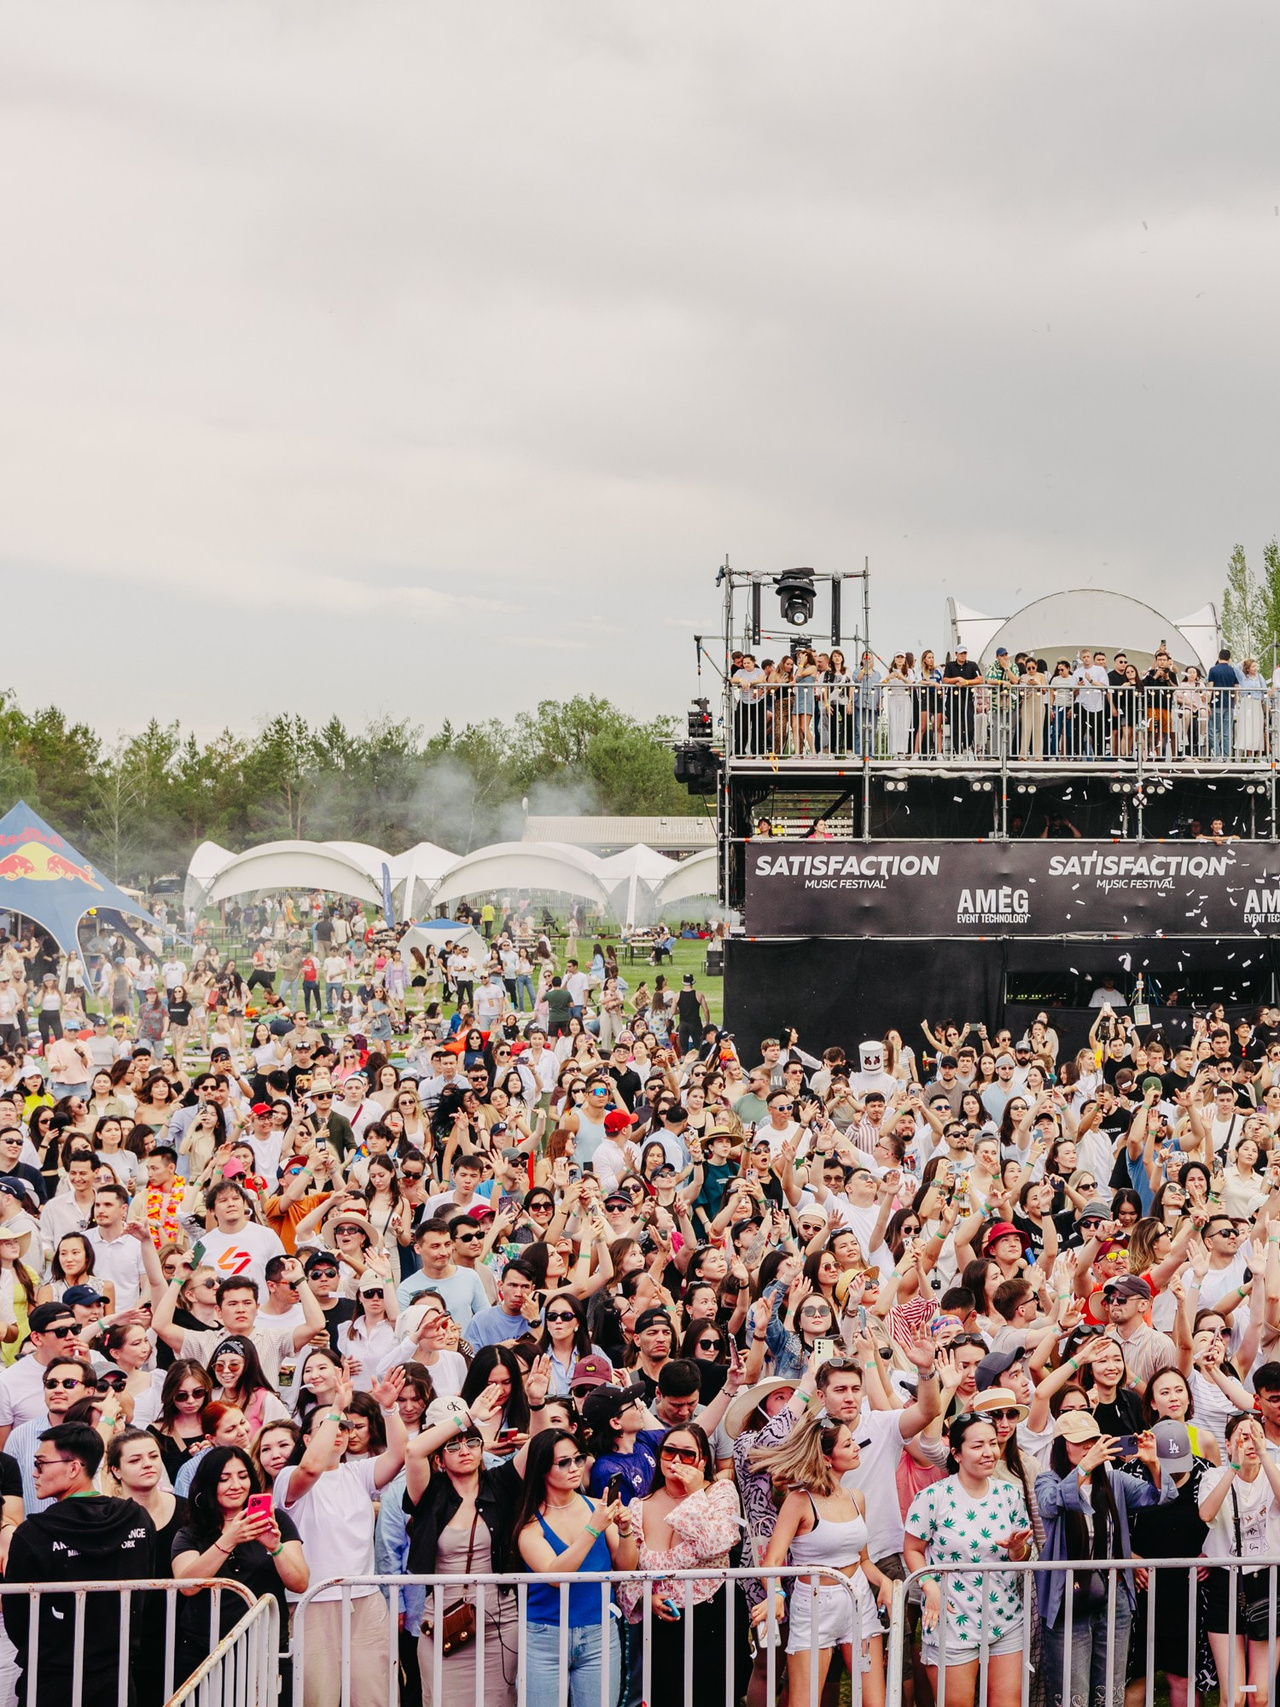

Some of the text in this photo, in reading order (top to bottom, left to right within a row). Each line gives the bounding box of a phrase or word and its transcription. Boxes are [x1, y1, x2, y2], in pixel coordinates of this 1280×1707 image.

[755, 855, 940, 877] SATISFACTION
[1048, 855, 1228, 877] SATISFACTION
[804, 879, 887, 889] MUSIC FESTIVAL
[1096, 878, 1176, 889] MUSIC FESTIVAL
[957, 888, 1029, 913] AMEG
[957, 914, 1029, 924] EVENT TECHNOLOGY
[1244, 913, 1266, 924] EVENT
[446, 1401, 461, 1411] CK
[1168, 1438, 1180, 1454] LA
